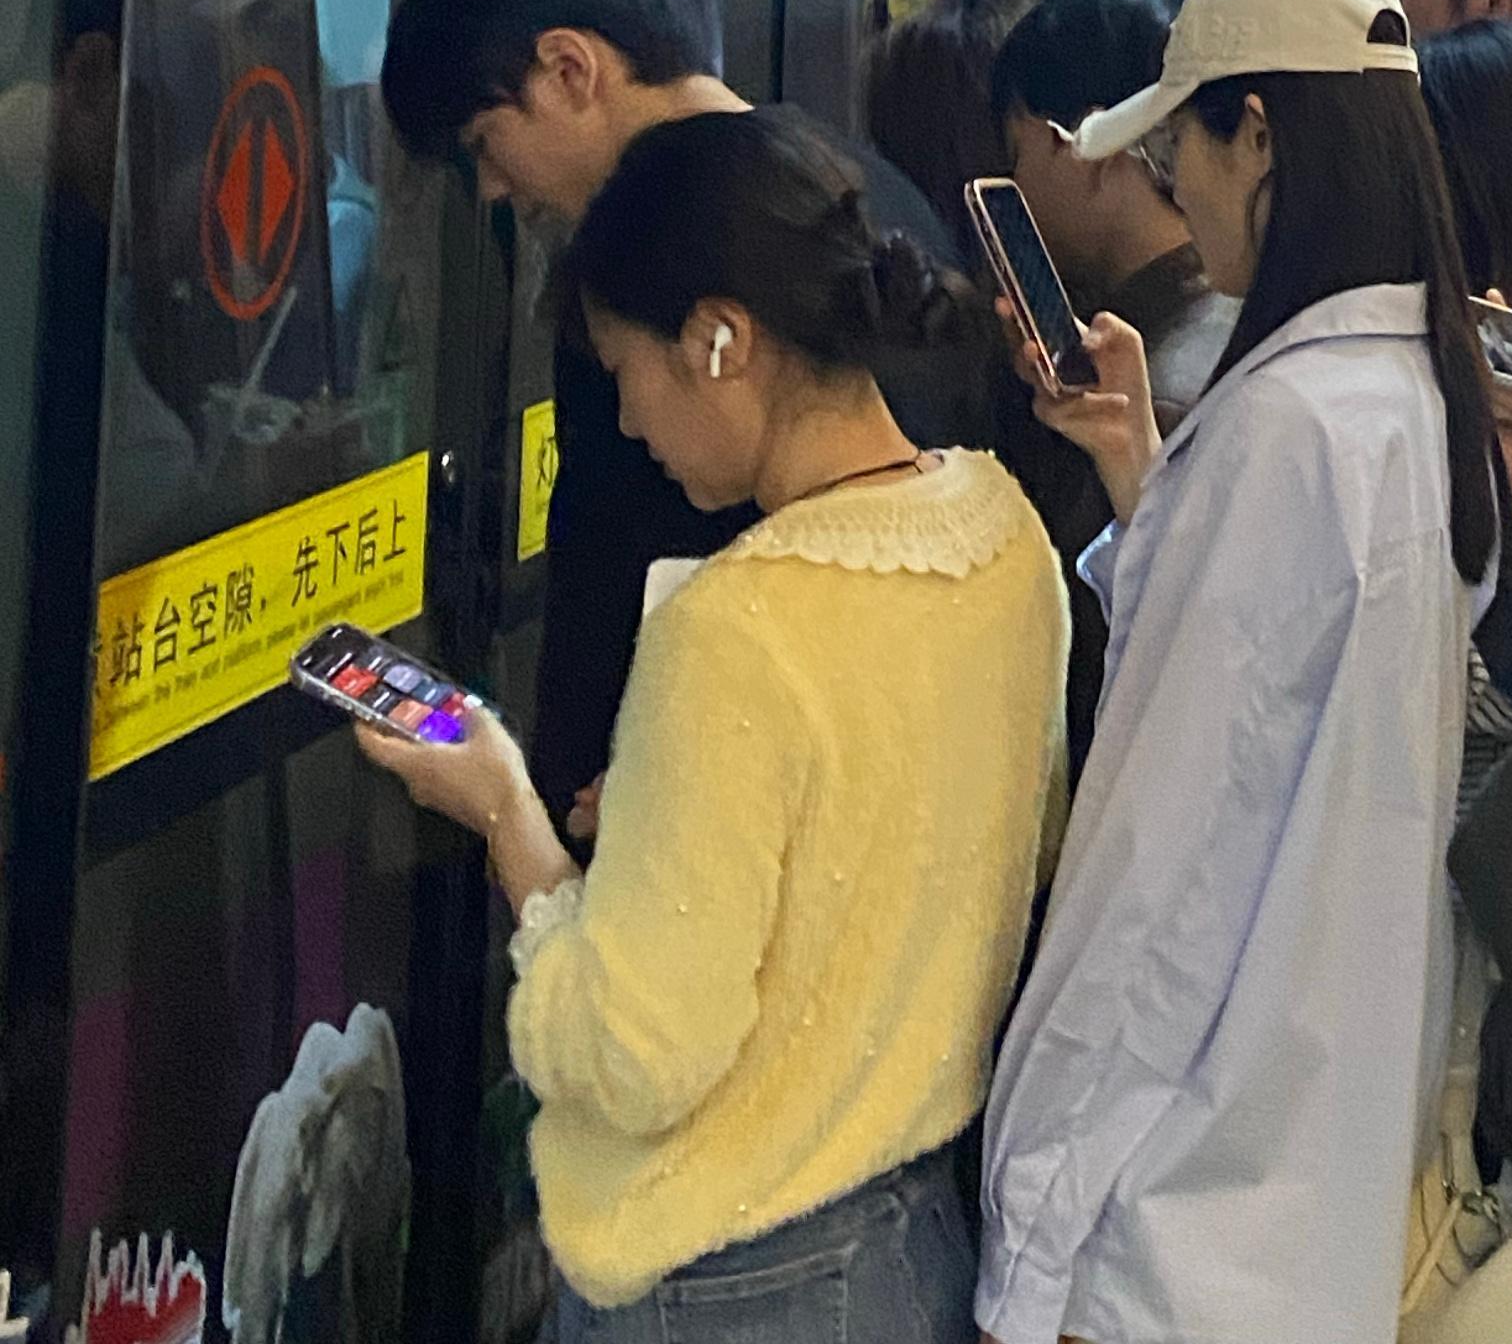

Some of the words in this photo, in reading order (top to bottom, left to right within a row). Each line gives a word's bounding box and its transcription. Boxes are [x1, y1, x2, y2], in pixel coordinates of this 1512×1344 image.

[96, 498, 407, 688] 站台空隙，先下后上
